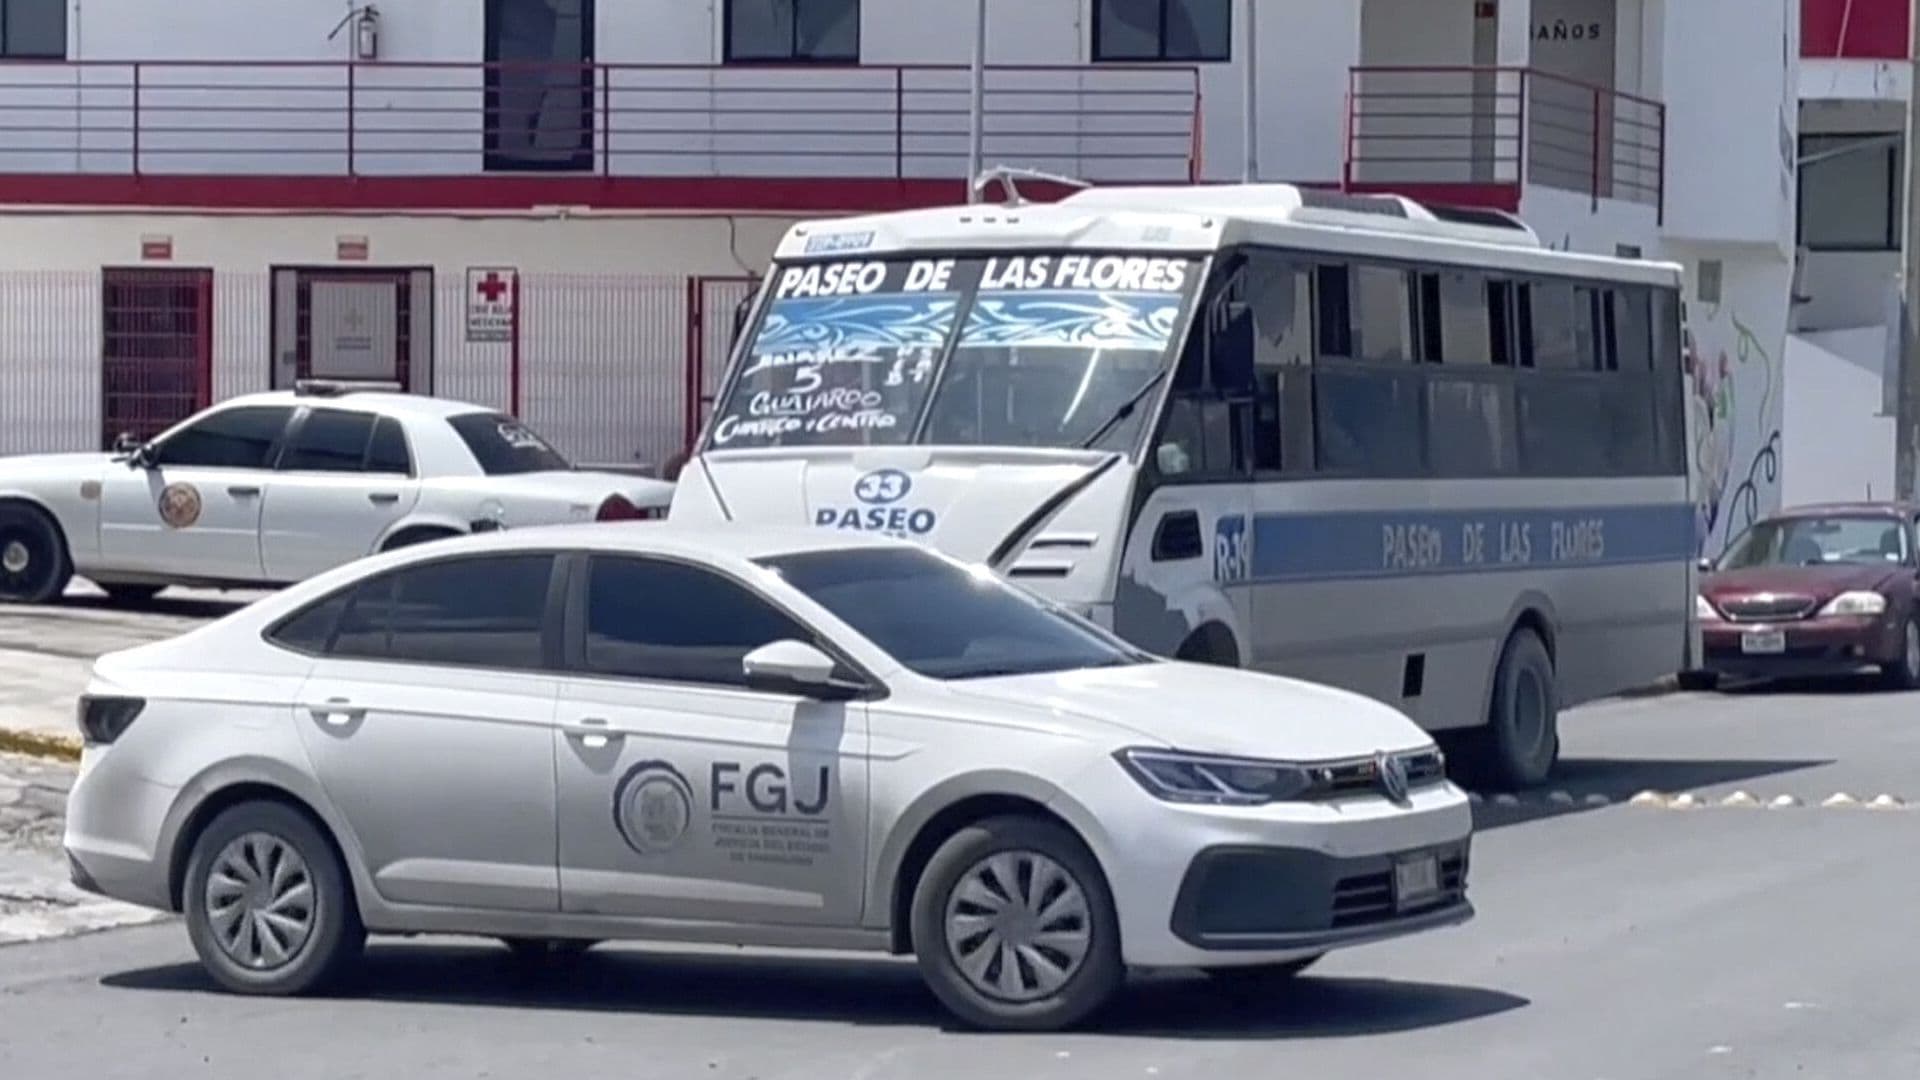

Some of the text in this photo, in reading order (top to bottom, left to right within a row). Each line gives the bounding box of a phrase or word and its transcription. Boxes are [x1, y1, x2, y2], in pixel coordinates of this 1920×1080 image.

[776, 255, 1188, 299] PASEO DE LAS FLORES
[787, 364, 822, 393] 5
[858, 474, 904, 499] 33
[815, 507, 936, 534] PASEO
[1382, 523, 1442, 568] PASEO
[1462, 522, 1485, 563] DE
[1500, 520, 1532, 564] LAS
[711, 761, 830, 815] FGJ
